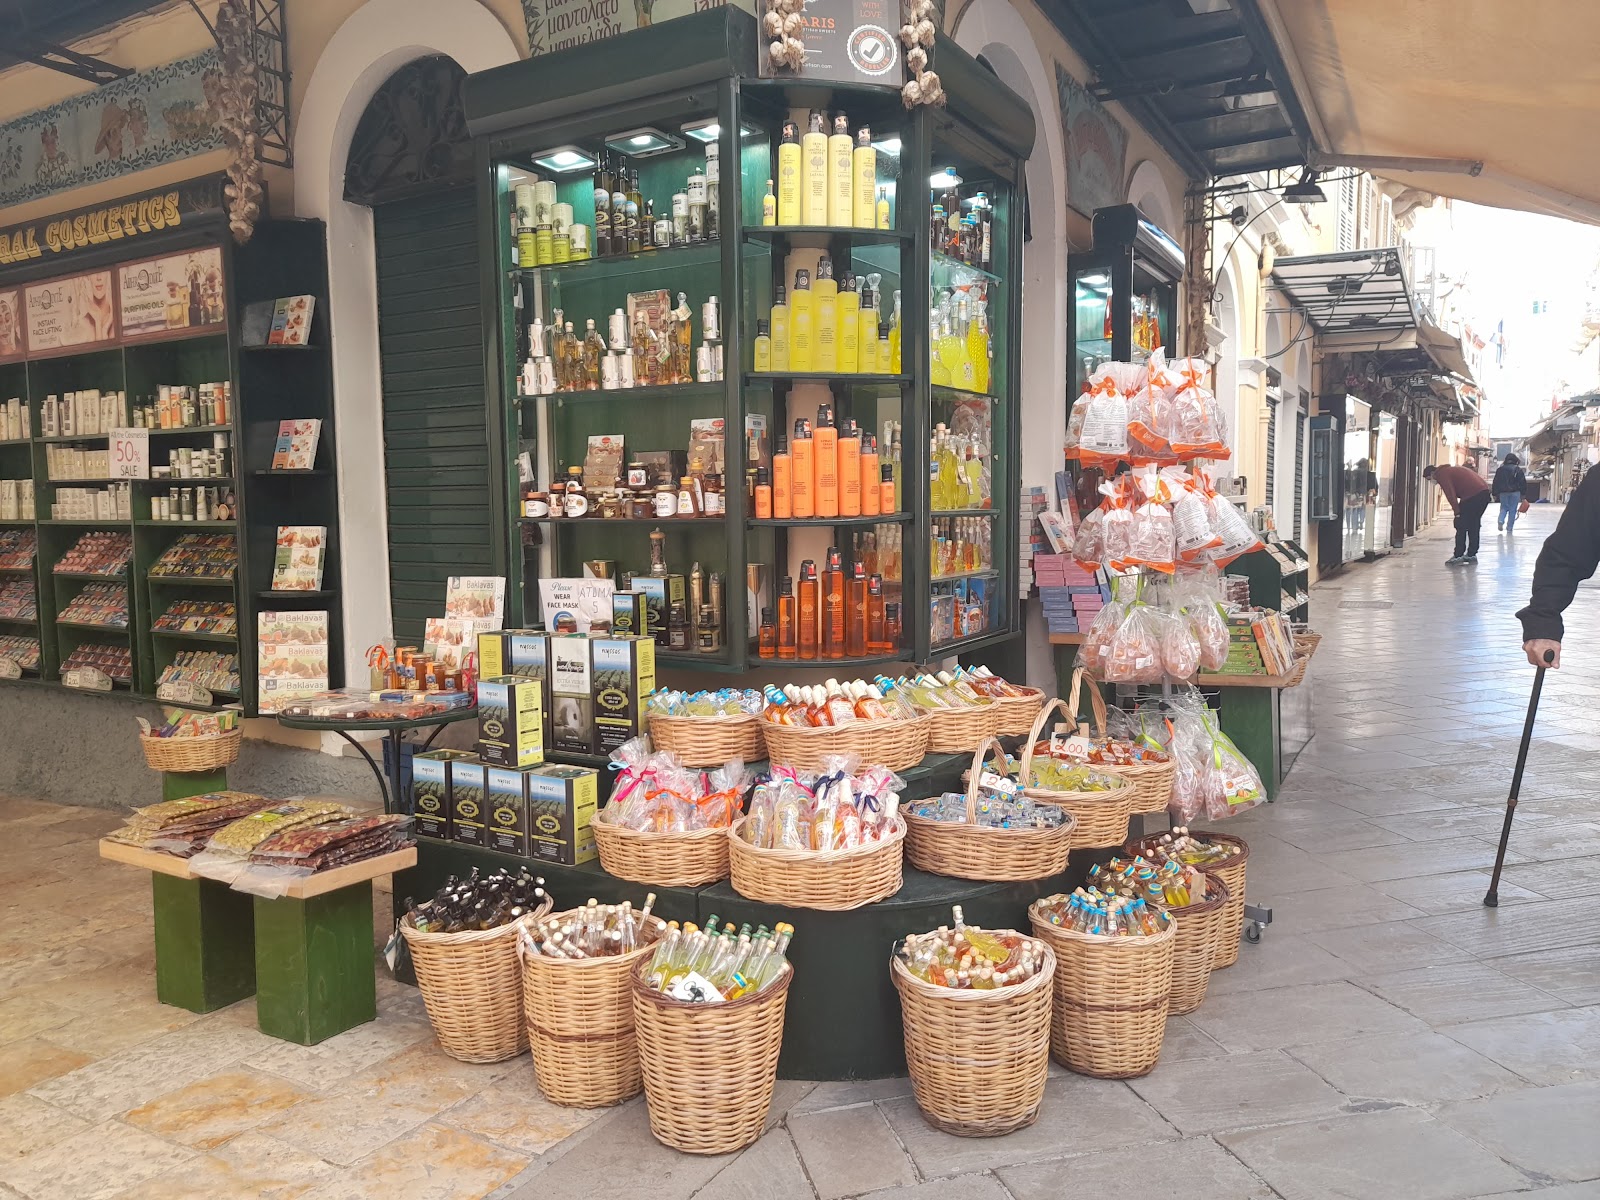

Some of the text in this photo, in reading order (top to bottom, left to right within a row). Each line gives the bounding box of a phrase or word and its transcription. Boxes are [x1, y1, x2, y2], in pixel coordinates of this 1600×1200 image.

[863, 1, 880, 9] WITH
[861, 10, 882, 18] LOVE
[801, 16, 835, 29] ARIS
[854, 30, 886, 44] CERTIFIED
[45, 191, 182, 253] COSMETICS
[124, 300, 165, 314] PURIFYING OILS
[37, 319, 56, 328] INSTANT
[33, 325, 62, 336] FACE LIFTING
[125, 430, 147, 439] Cosmetics
[116, 440, 141, 463] 50%
[120, 464, 138, 477] SALE
[466, 580, 494, 589] Baklavas
[550, 582, 573, 592] Please
[285, 613, 323, 622] Baklavas
[473, 619, 491, 629] klavas
[288, 647, 323, 655] Baklavas
[286, 681, 324, 690] Baklavas
